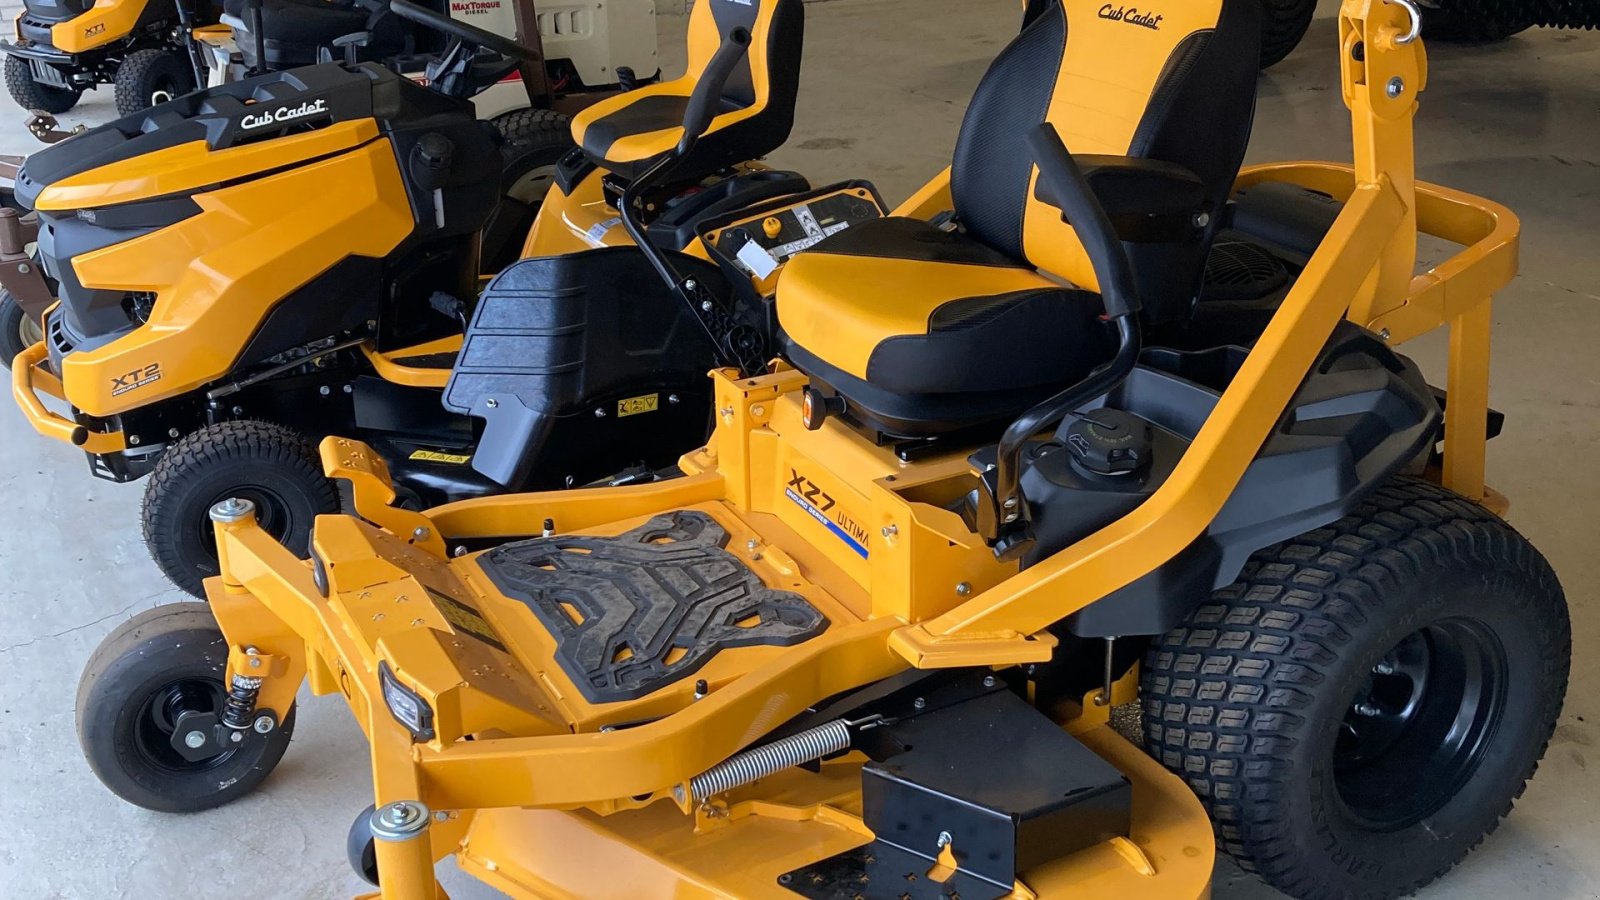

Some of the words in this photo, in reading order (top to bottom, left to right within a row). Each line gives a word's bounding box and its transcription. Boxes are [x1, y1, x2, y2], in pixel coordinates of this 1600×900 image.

[85, 22, 104, 34] XT1
[1097, 3, 1125, 21] Cub
[1123, 8, 1163, 30] Cadet
[241, 111, 274, 130] Cub
[274, 98, 326, 122] Cadet
[110, 363, 160, 390] XT2
[786, 489, 808, 510] ENDURO
[808, 506, 829, 525] SERIES
[787, 468, 836, 512] XZ7
[837, 511, 869, 547] ULTIMA
